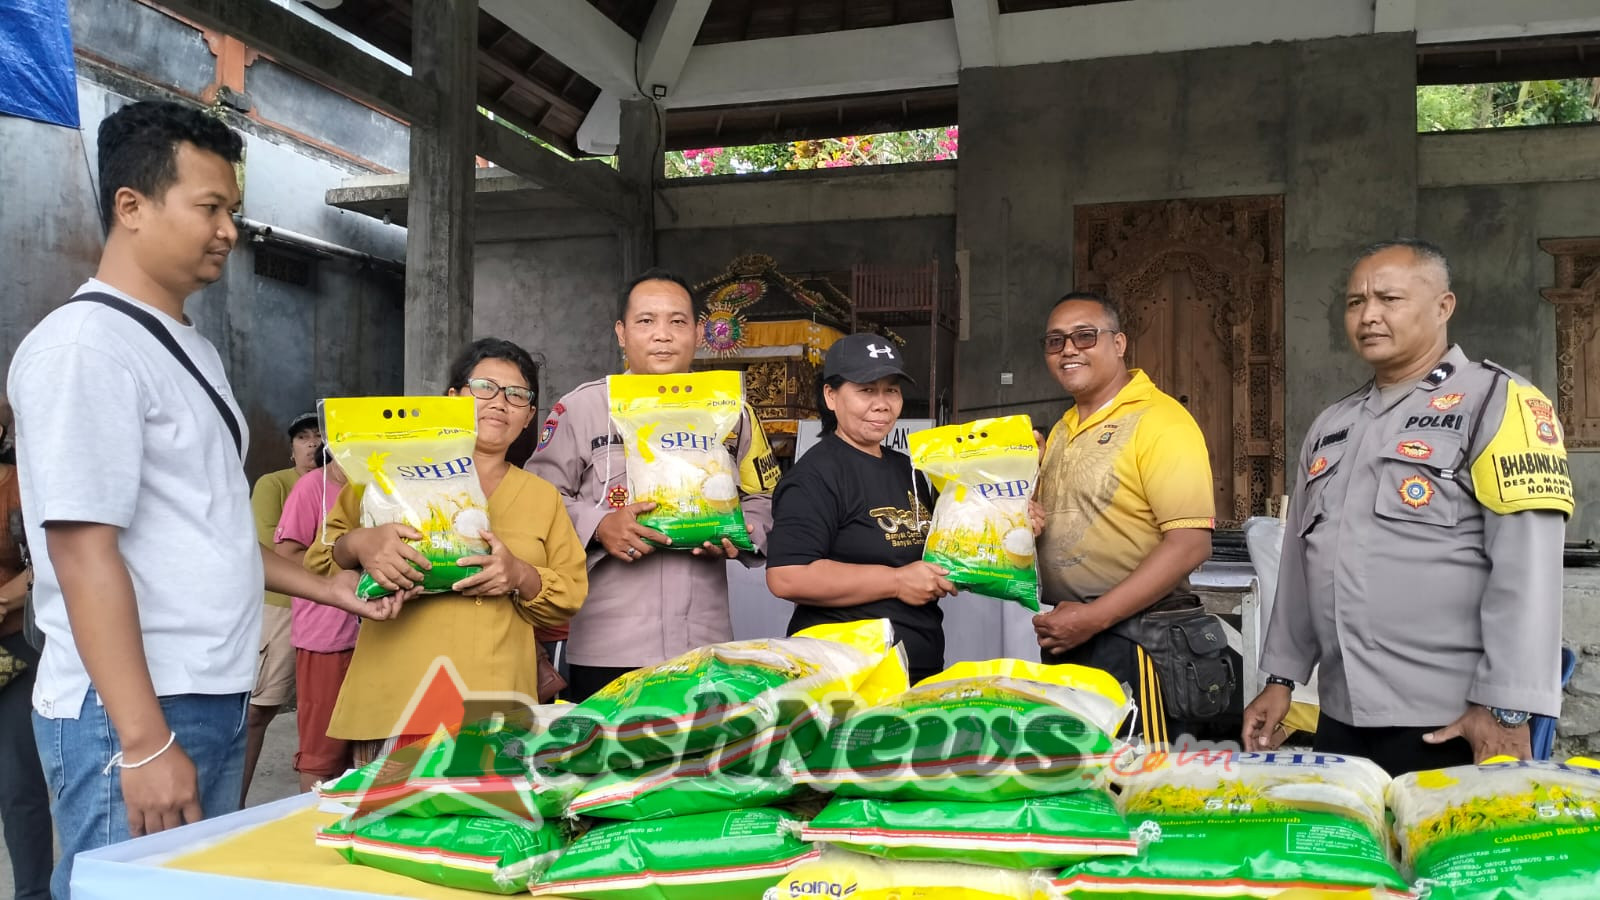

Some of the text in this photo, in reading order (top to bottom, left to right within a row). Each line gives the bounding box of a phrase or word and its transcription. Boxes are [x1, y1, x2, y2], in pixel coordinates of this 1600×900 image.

[1405, 414, 1464, 430] POLRI
[397, 456, 473, 479] SPHP
[1503, 477, 1536, 488] DESA
[1527, 485, 1566, 495] NOMOR
[1204, 799, 1224, 811] 5
[1538, 806, 1560, 817] 5
[1494, 830, 1554, 844] Cadangan
[1555, 826, 1591, 837] Beras
